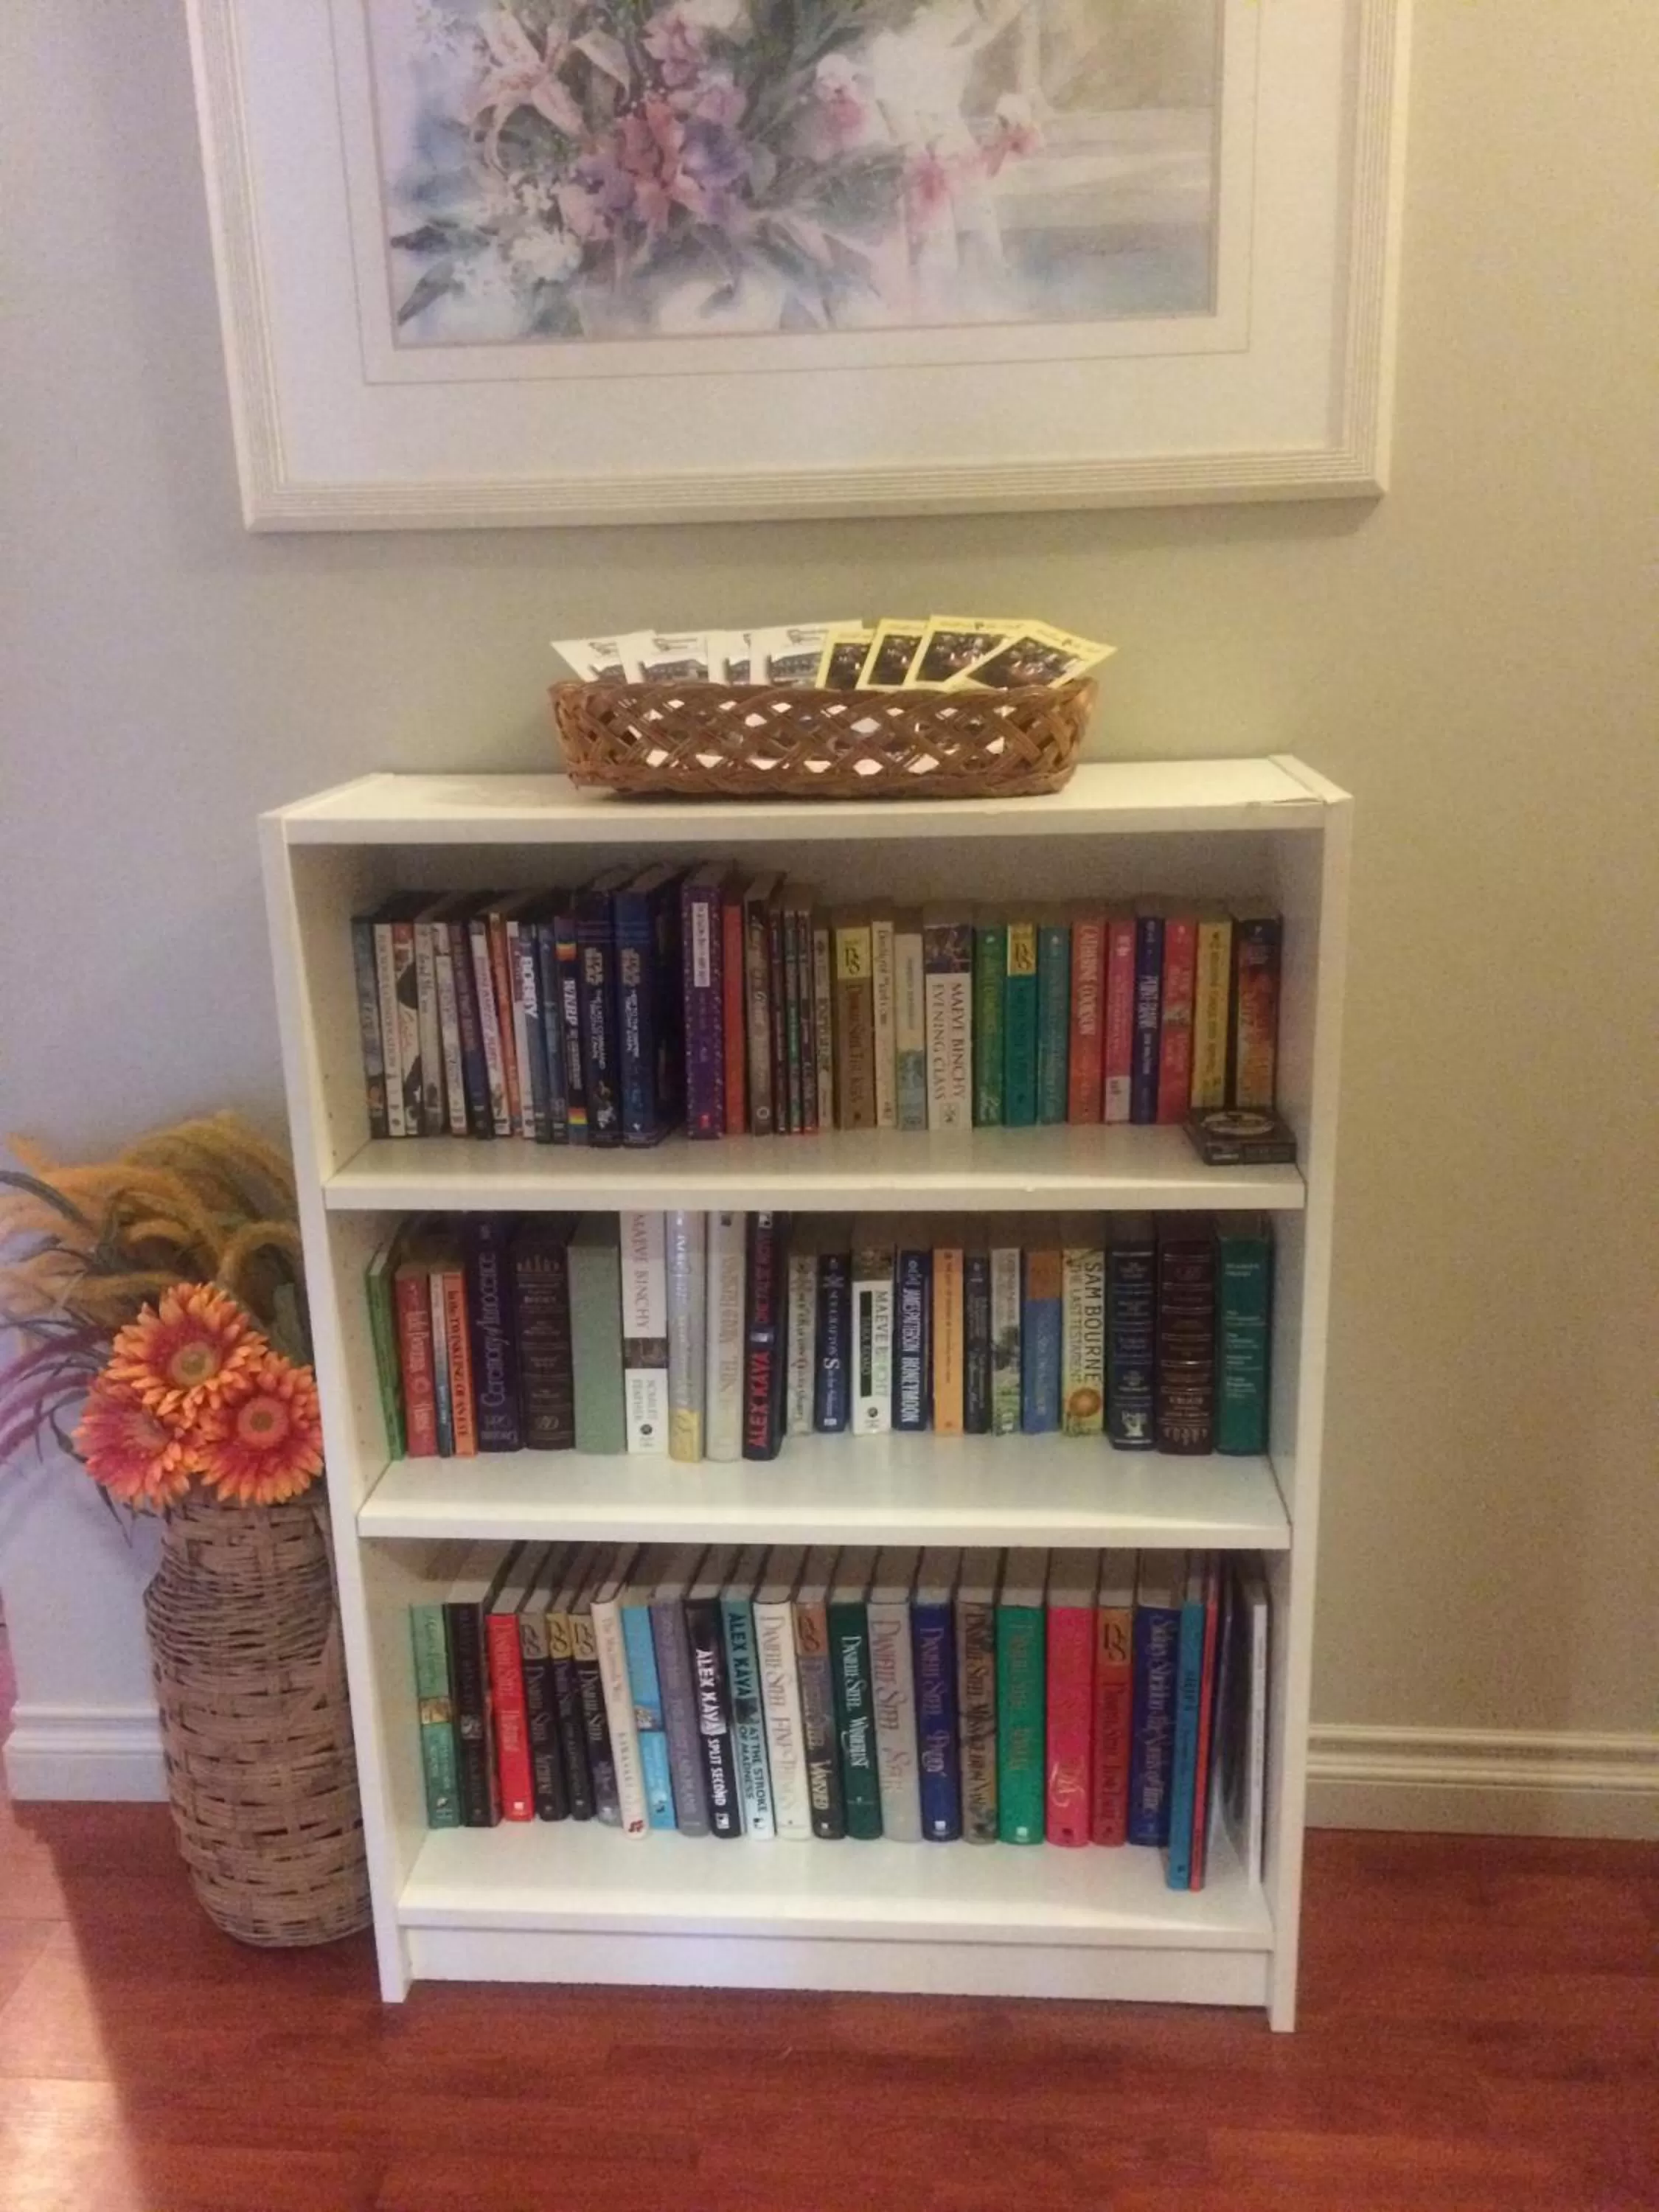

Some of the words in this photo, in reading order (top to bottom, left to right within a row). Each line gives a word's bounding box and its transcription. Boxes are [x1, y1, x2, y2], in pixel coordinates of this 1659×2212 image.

[931, 983, 946, 1053] EVENING
[950, 983, 965, 1032] MAEVE
[933, 1057, 946, 1101] CLASS
[951, 1038, 965, 1099] BINCHY
[631, 1214, 648, 1263] MAEVE
[634, 1270, 650, 1330] BINCHY
[902, 1287, 920, 1312] JAMES
[1085, 1262, 1102, 1299] SAM
[874, 1290, 888, 1343] MAEVE
[1084, 1305, 1102, 1382] BOURNE
[750, 1352, 770, 1397] KAVA
[901, 1357, 921, 1422] HONEYMOON
[749, 1403, 768, 1448] ALEX
[728, 1613, 748, 1652] ALEX
[871, 1620, 901, 1684] DANIELLE
[695, 1649, 713, 1688] ALEX
[733, 1657, 752, 1696] KAVA
[700, 1691, 720, 1733] KAVA
[845, 1678, 867, 1708] STEEL
[875, 1687, 908, 1731] STEEL
[707, 1739, 721, 1764] SPLIT
[739, 1725, 748, 1742] OF
[748, 1726, 759, 1744] AT
[751, 1745, 762, 1764] THE
[711, 1767, 727, 1806] SECOND
[741, 1742, 754, 1800] MADNESS
[754, 1767, 768, 1813] STROKE
